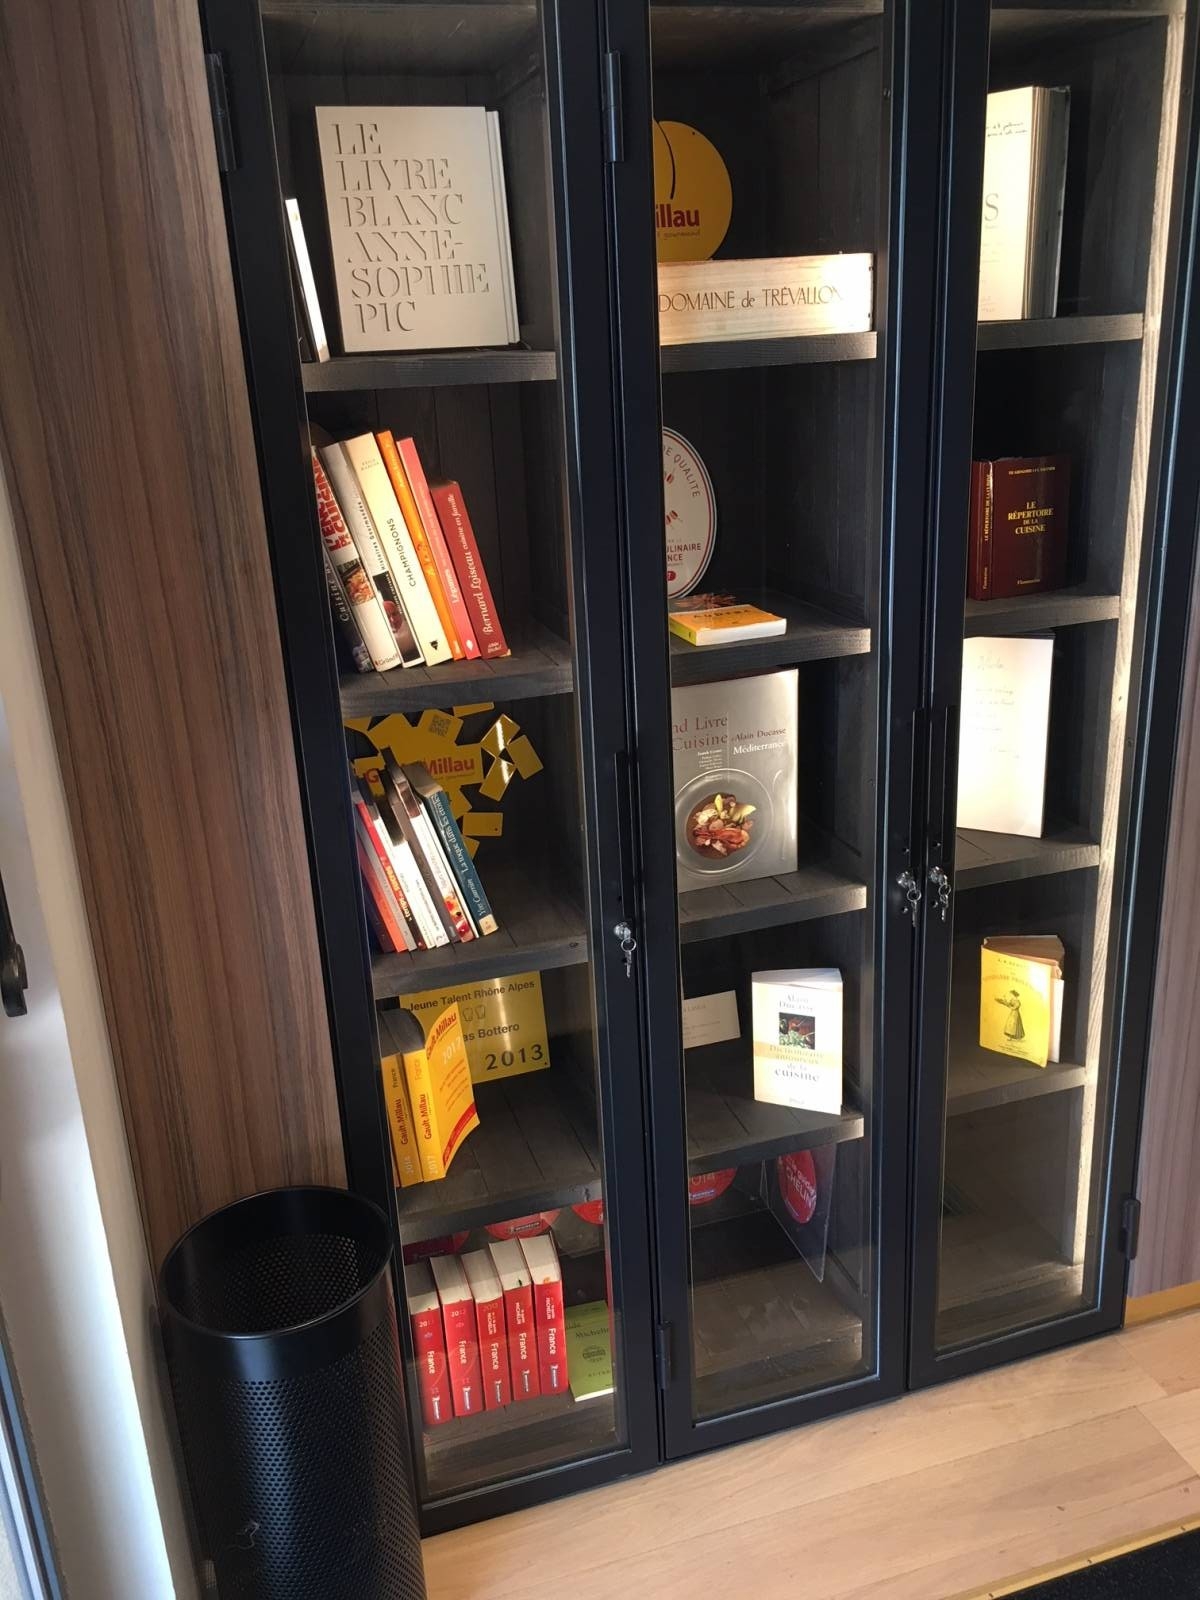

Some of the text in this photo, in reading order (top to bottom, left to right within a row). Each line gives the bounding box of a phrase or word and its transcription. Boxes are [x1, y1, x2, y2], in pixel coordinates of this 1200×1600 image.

[332, 123, 382, 155] LE
[336, 158, 452, 192] LIVRE
[340, 194, 464, 227] BLANC
[656, 203, 700, 228] illau
[347, 230, 464, 263] ANNE-
[351, 263, 490, 299] SOPHIE
[658, 290, 735, 313] DOMAINE
[741, 294, 756, 308] de
[354, 301, 416, 333] PIC
[1026, 501, 1036, 510] LE
[357, 501, 387, 571] Histoires Gourmandes
[1015, 524, 1047, 535] CUISINE
[386, 517, 417, 588] CHAMPIGNONS
[466, 549, 485, 595] Loiseau
[329, 575, 350, 622] Cuisine
[476, 593, 494, 635] Bernard
[672, 716, 728, 734] nd Livre
[757, 727, 787, 738] Ducasse
[444, 826, 457, 844] dans
[451, 843, 464, 863] toque
[458, 861, 469, 873] La
[398, 896, 412, 919] temps
[408, 980, 535, 1013] Jeune Talent Rhône Alpes
[478, 1022, 520, 1039] Bottero
[485, 1043, 544, 1071] 2013
[774, 1069, 820, 1082] cuisine
[427, 1154, 438, 1175] 2017
[457, 1340, 469, 1364] France
[517, 1332, 530, 1360] France
[546, 1328, 559, 1355] France
[425, 1350, 438, 1375] France
[489, 1343, 501, 1370] France
